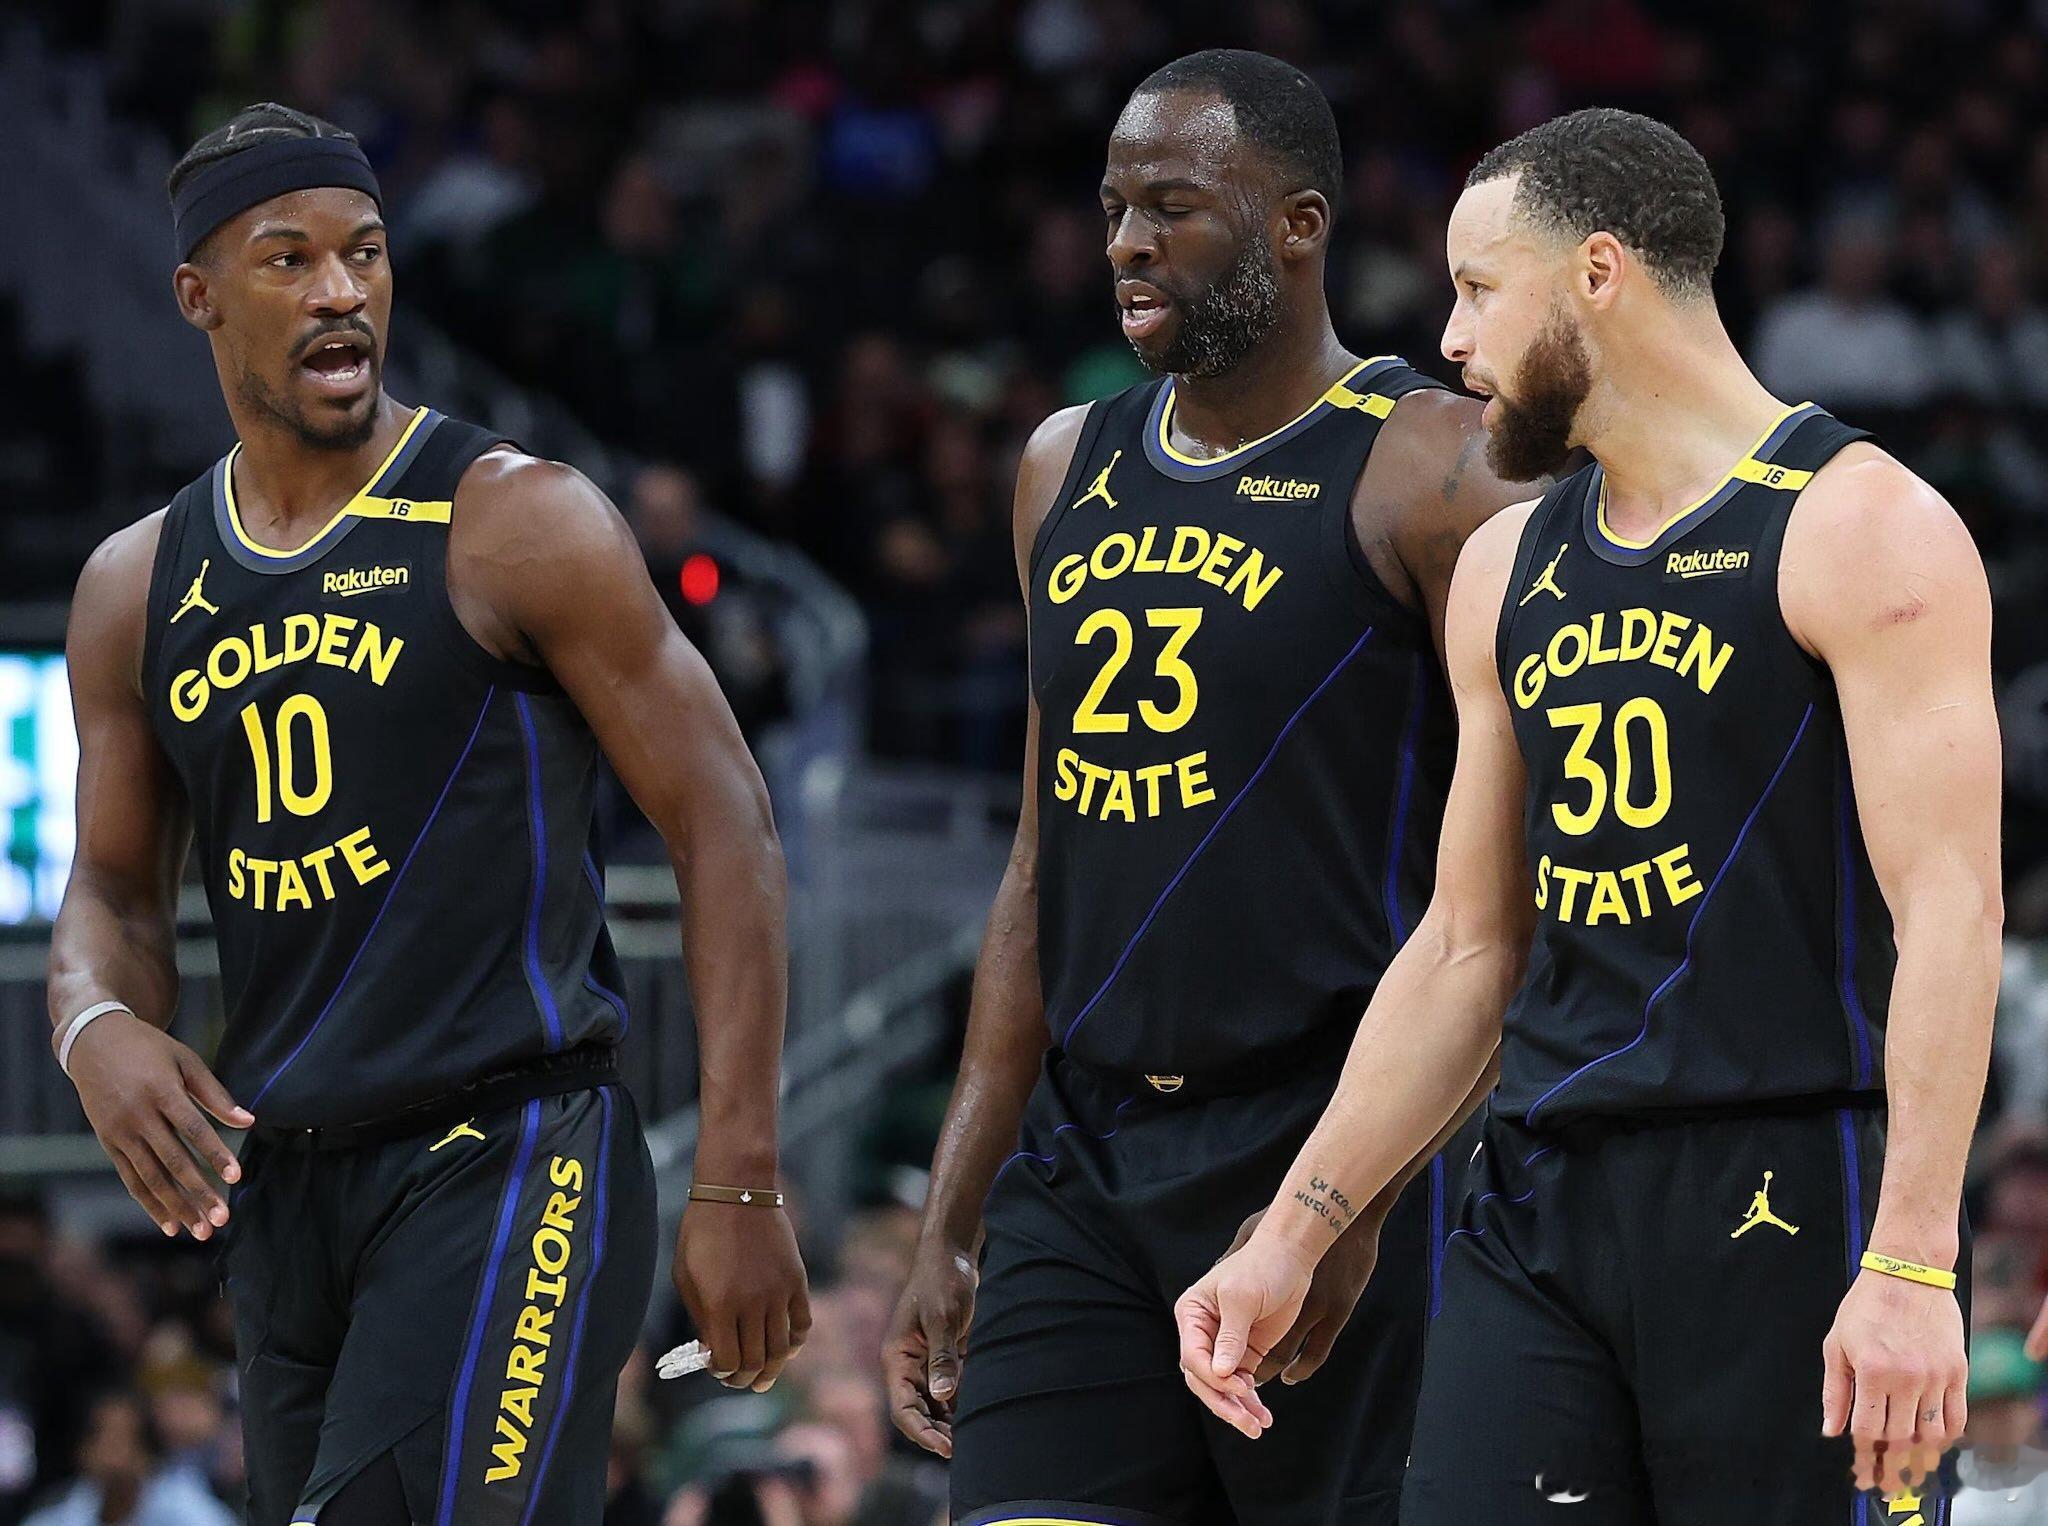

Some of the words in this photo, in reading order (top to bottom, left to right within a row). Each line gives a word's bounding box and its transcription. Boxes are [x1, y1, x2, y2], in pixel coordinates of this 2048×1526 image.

[388, 500, 411, 517] 16
[1235, 474, 1321, 502] Rakuten
[1762, 467, 1785, 485] 16
[322, 565, 409, 598] Rakuten
[1047, 525, 1284, 612] GOLDEN
[1665, 548, 1750, 579] Rakuten
[169, 613, 405, 723] GOLDEN
[1072, 607, 1204, 734] 23
[1513, 607, 1735, 710] GOLDEN
[240, 693, 333, 823] 10
[1054, 747, 1216, 823] STATE
[1546, 696, 1672, 836] 30
[228, 827, 391, 912] STATE
[1534, 843, 1704, 926] STATE
[484, 1156, 583, 1483] WARRIORS
